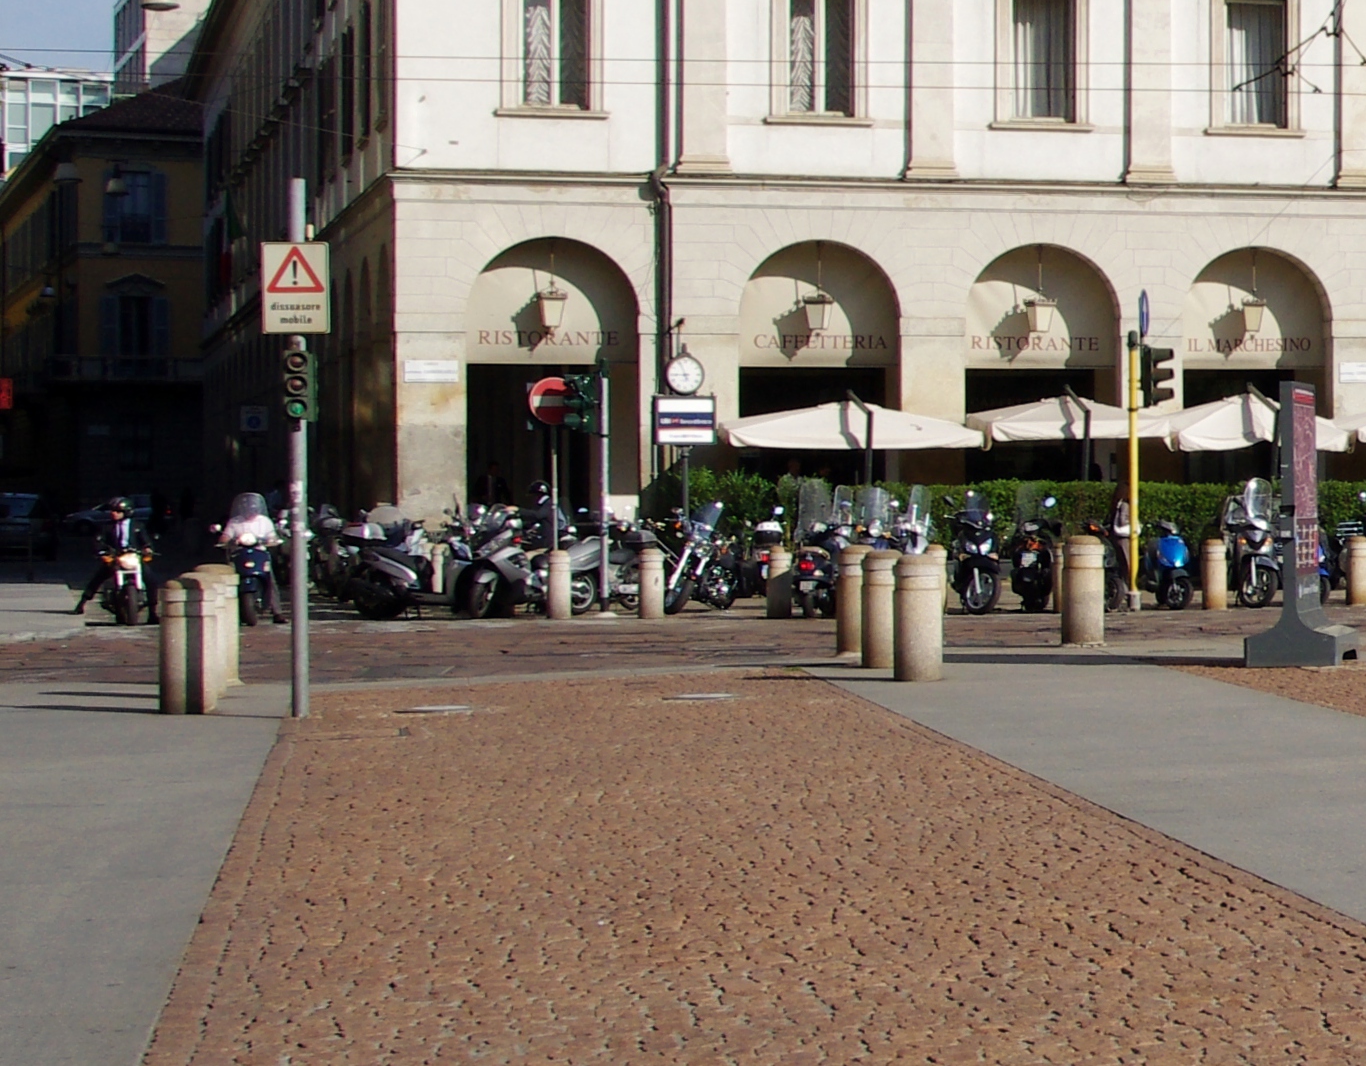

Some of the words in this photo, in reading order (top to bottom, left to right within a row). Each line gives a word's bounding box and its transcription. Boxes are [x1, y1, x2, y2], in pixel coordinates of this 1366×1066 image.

[270, 302, 321, 311] dissuasore
[280, 314, 312, 324] mobile
[477, 330, 619, 346] RISTORANTE
[753, 334, 887, 349] CAFFETTERIA
[970, 335, 1100, 351] RISTORANTE
[1187, 338, 1203, 352] IL
[1207, 337, 1311, 352] MARCHESINO
